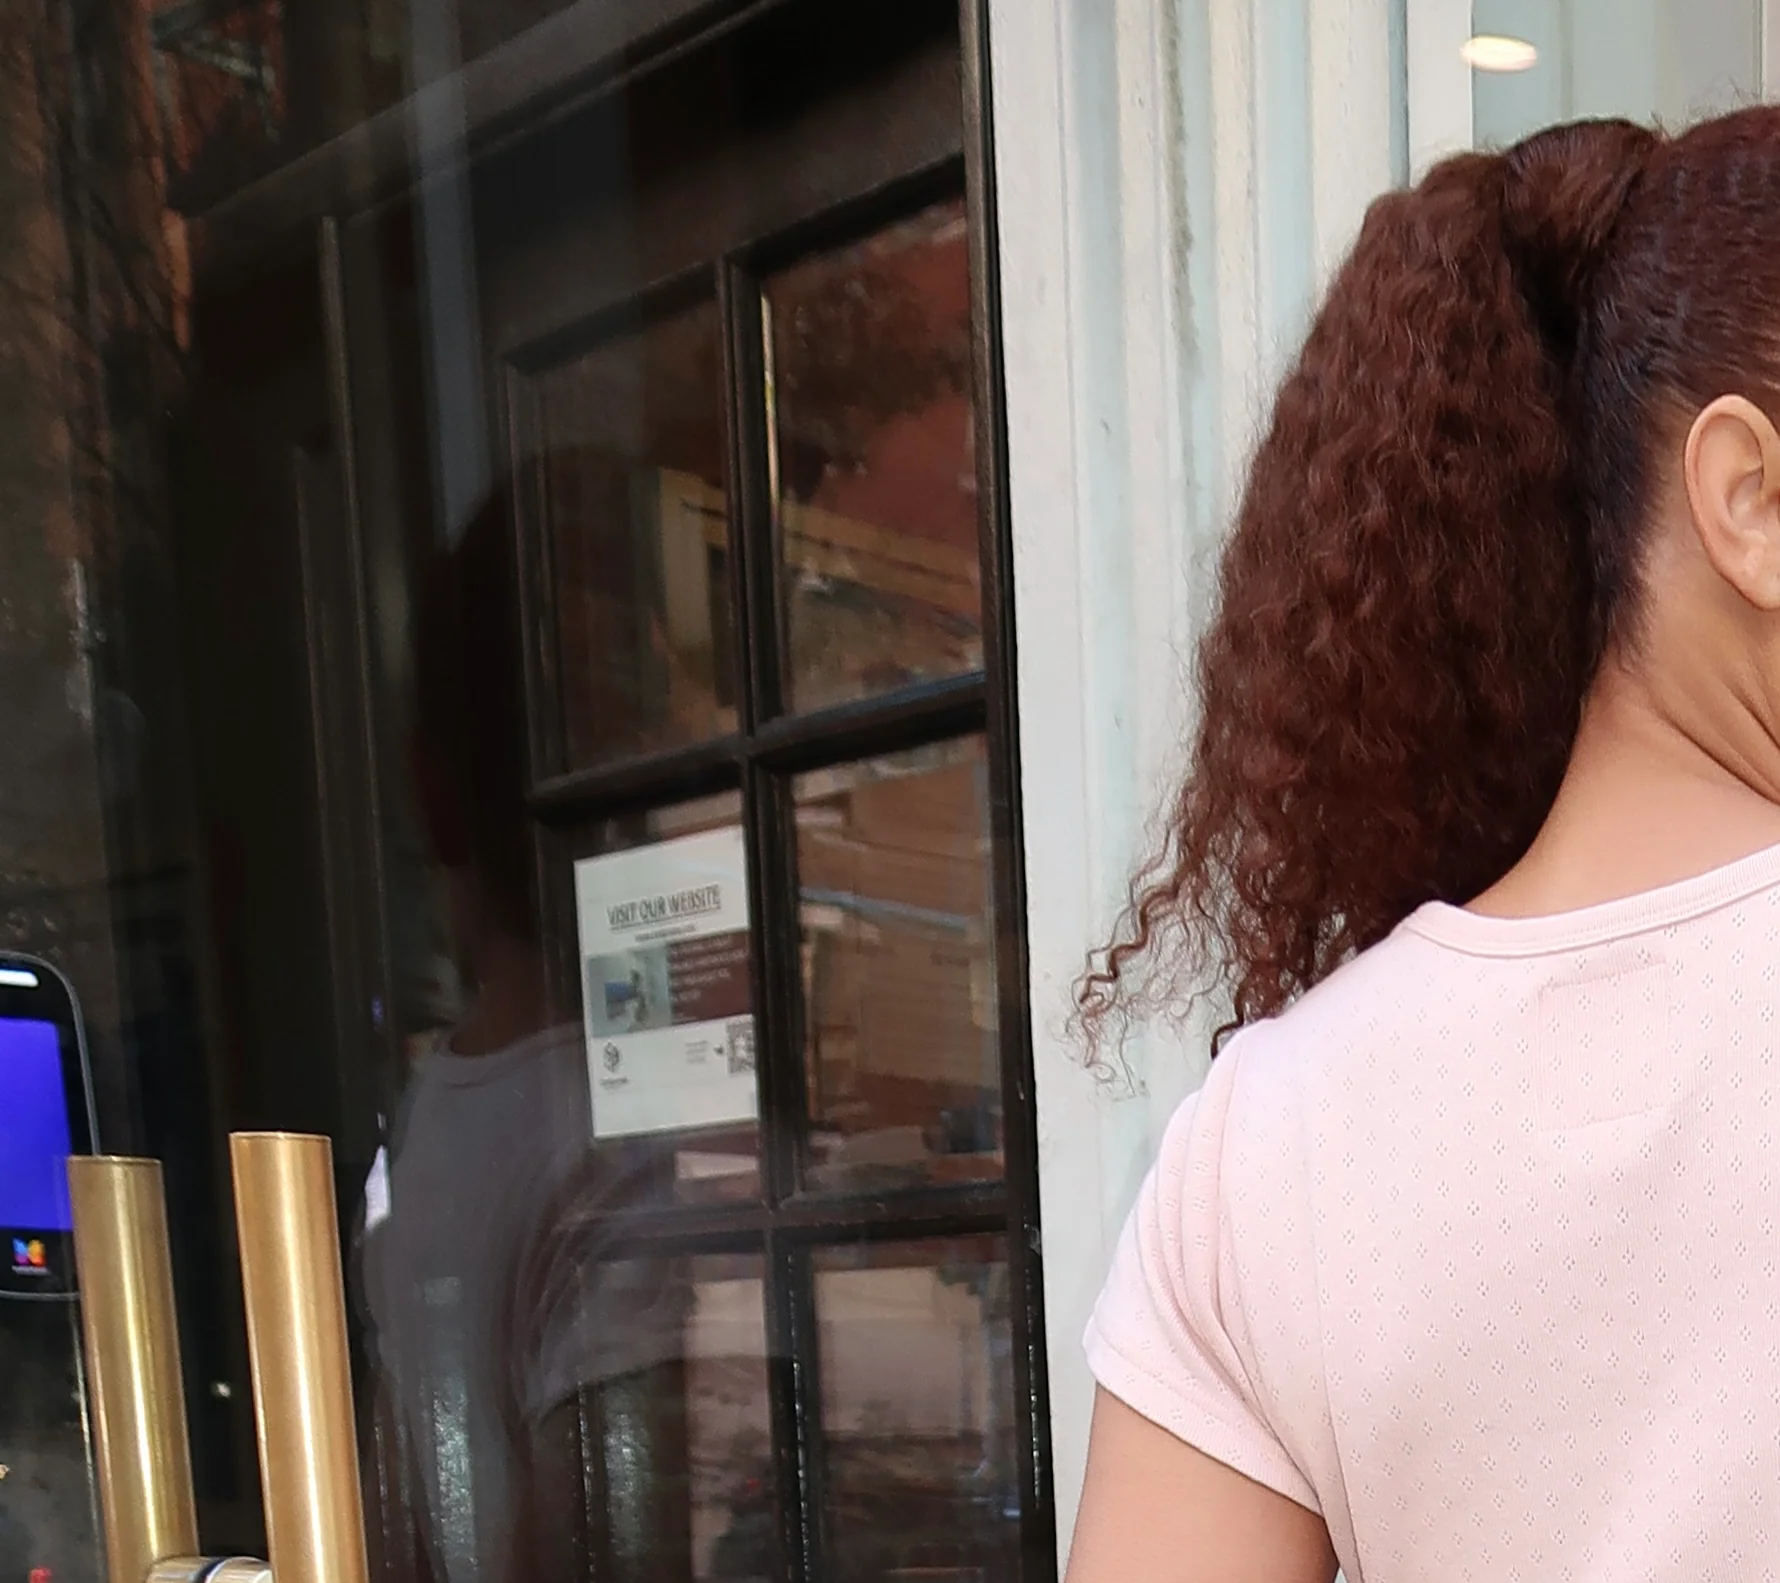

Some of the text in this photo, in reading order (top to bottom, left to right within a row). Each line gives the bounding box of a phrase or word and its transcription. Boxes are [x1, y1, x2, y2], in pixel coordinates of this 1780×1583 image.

[607, 884, 721, 926] VISIT OUR WEBSITE
